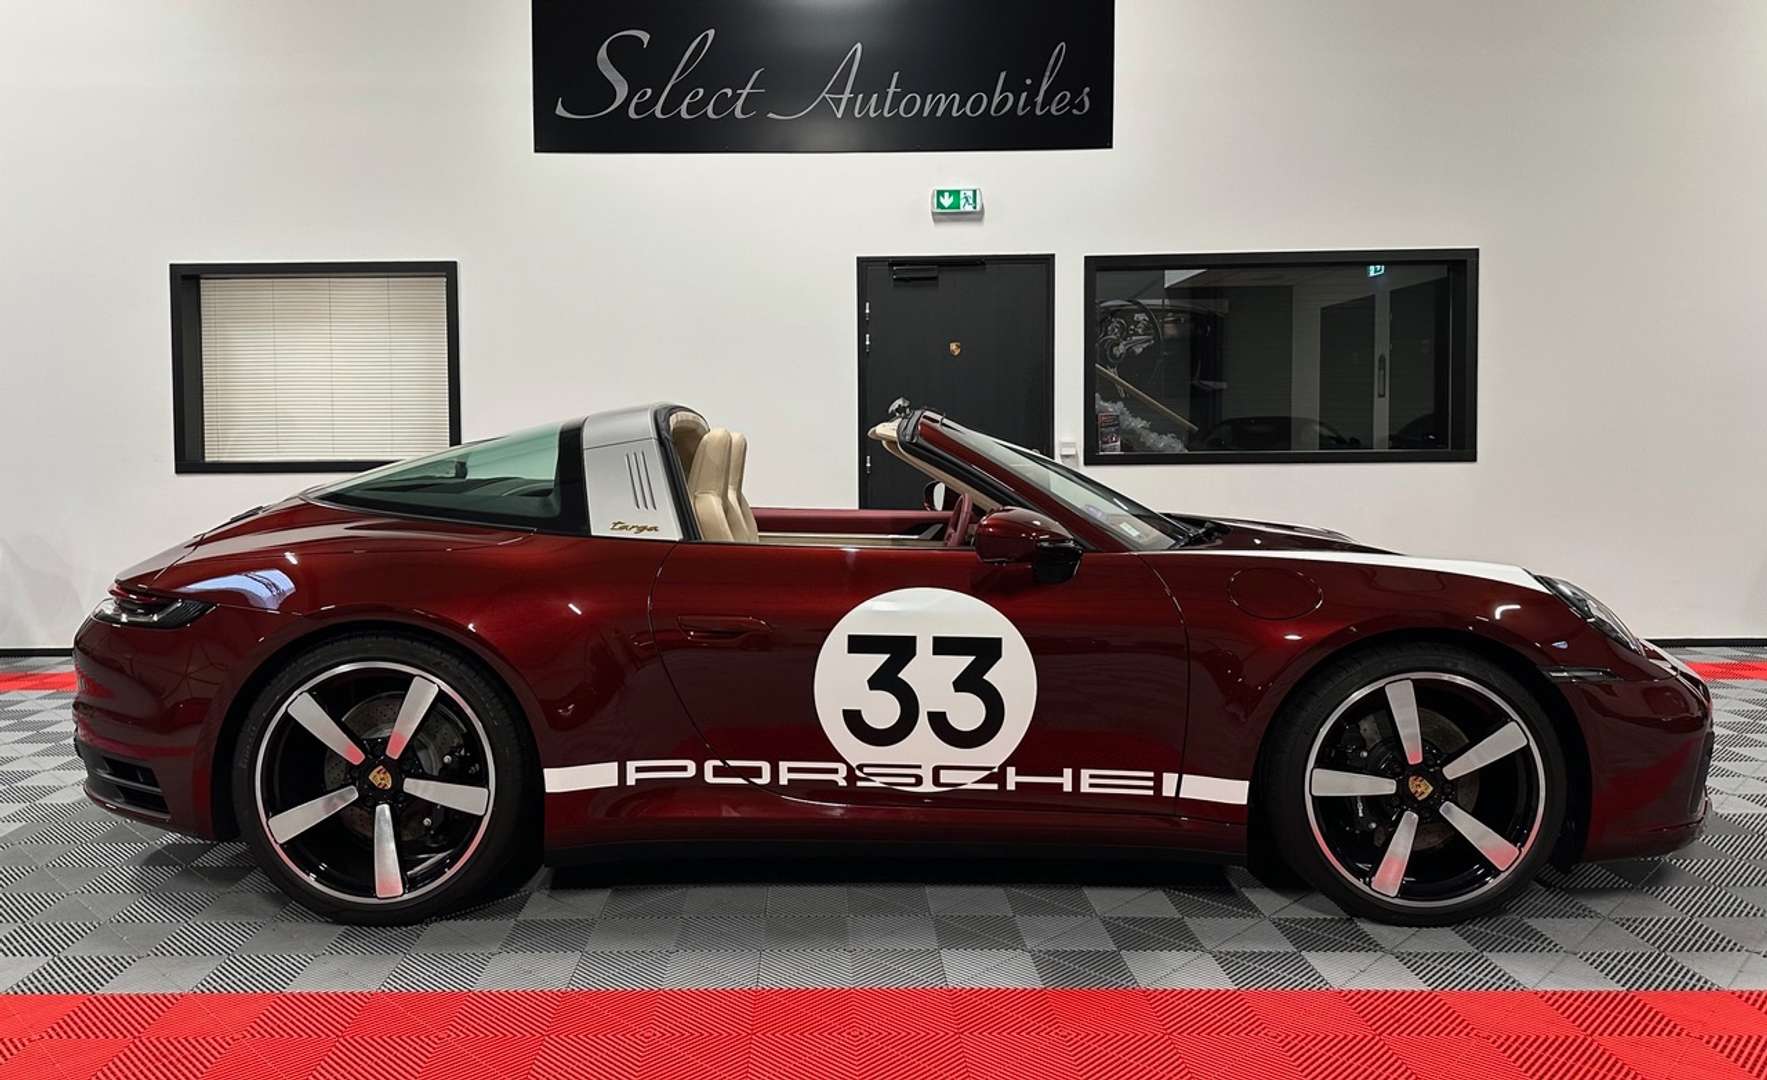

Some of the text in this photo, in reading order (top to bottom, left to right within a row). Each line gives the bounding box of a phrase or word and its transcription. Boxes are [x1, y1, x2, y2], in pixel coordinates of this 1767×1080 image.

[555, 28, 1091, 120] Select Automobiles
[609, 520, 659, 534] targa
[842, 634, 1006, 750] 33
[625, 758, 1155, 796] PORSCHE
